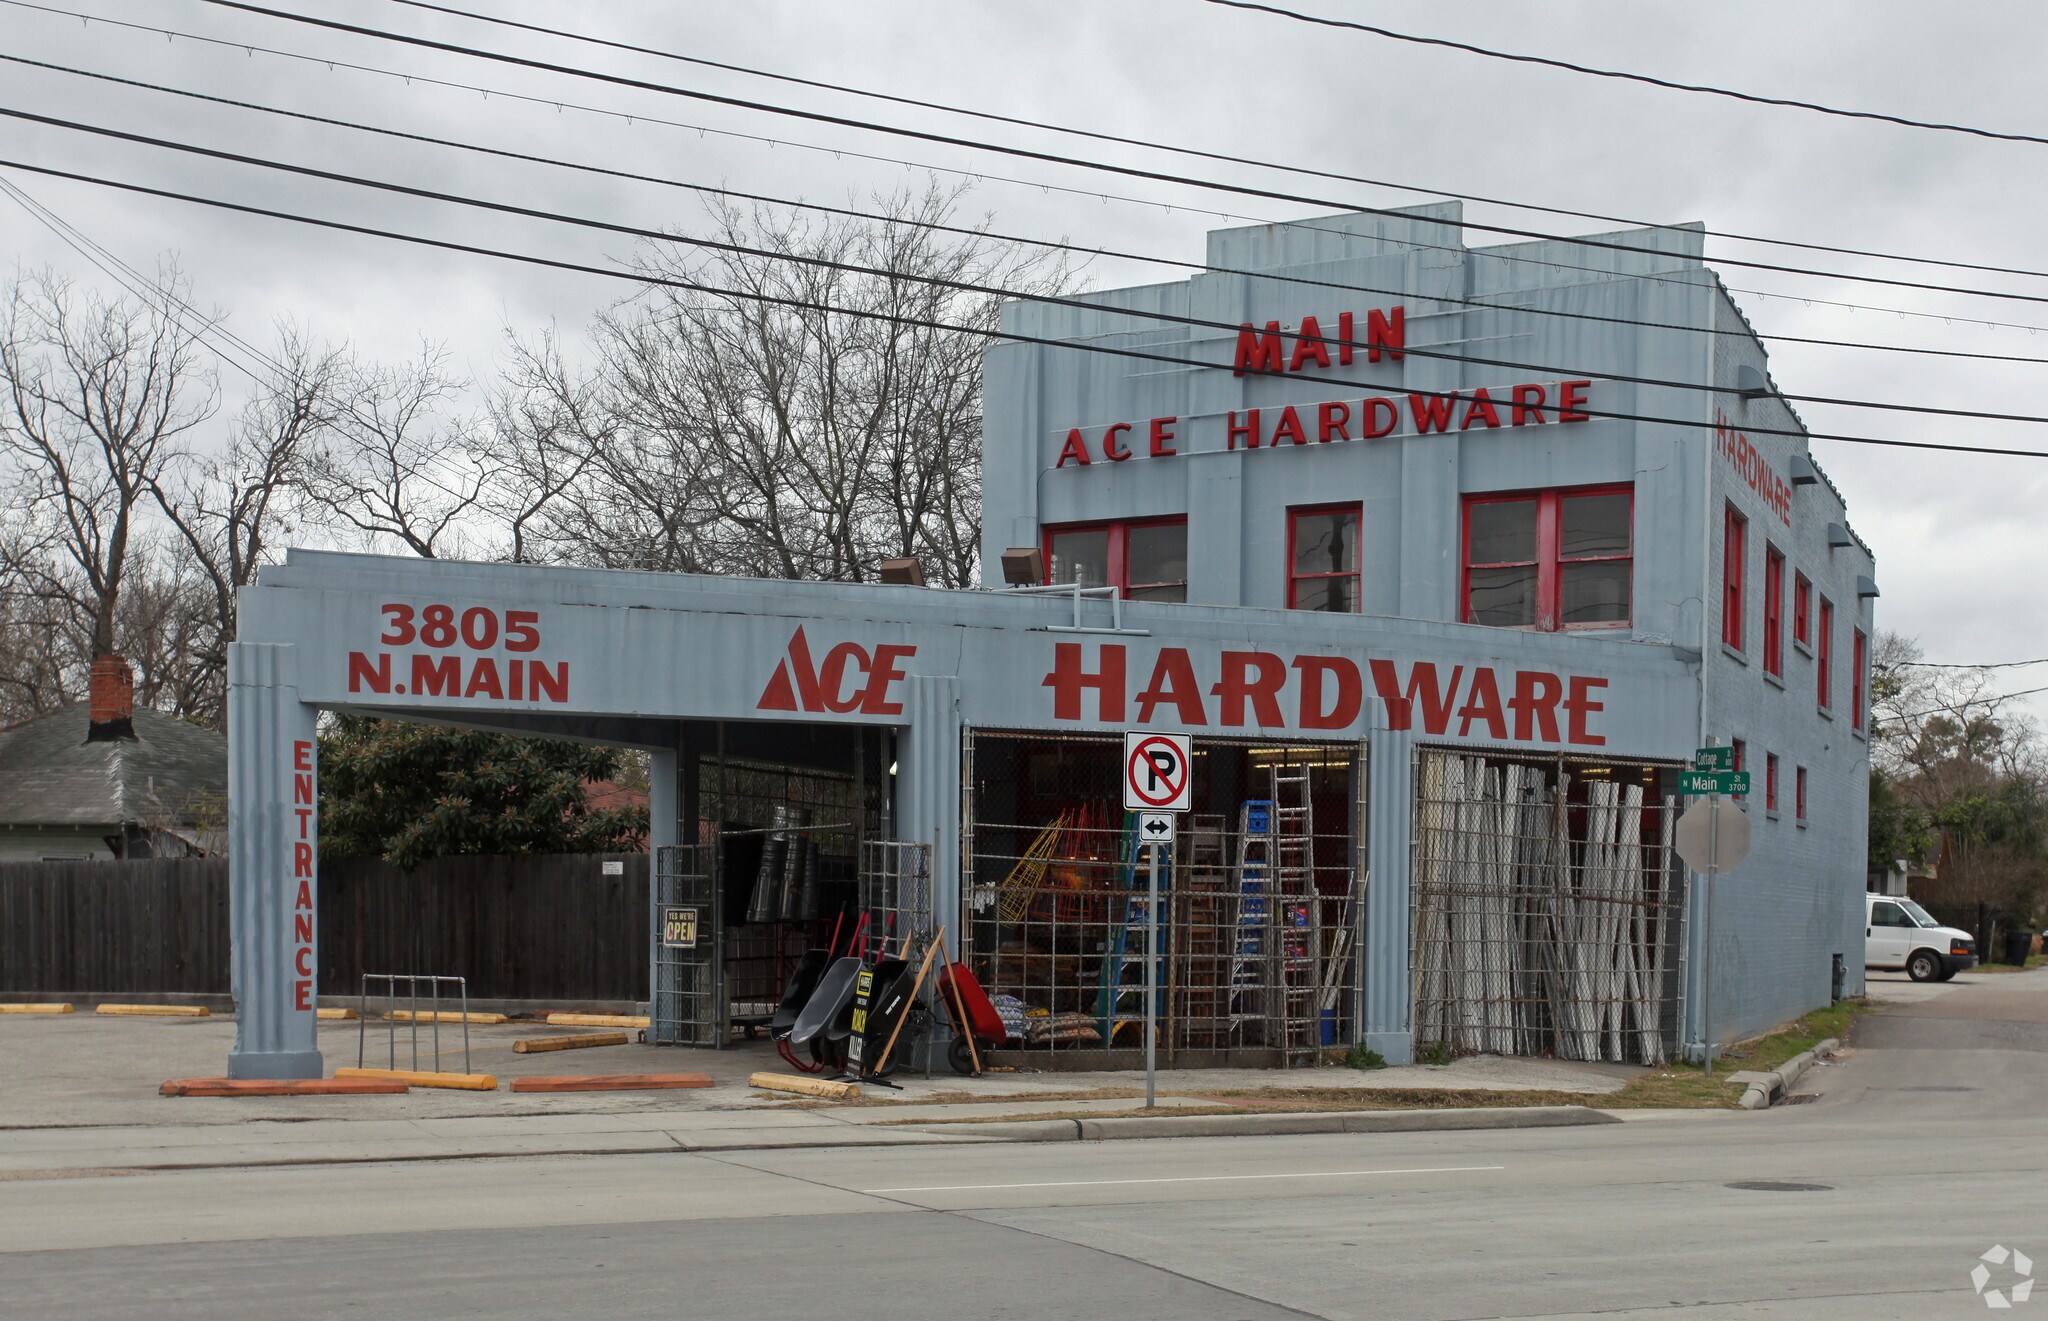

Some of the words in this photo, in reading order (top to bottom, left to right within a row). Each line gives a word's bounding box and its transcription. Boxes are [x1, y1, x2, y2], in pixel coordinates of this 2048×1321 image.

[1233, 306, 1405, 377] MAIN
[1056, 416, 1177, 468] ACE
[1227, 380, 1592, 451] HARDWARE
[1717, 407, 1792, 528] HARDWARE
[382, 603, 540, 652] 3805
[348, 652, 570, 703] N.MAIN
[759, 623, 917, 716] ACE
[1041, 642, 1608, 747] HARDWARE
[1148, 750, 1176, 792] P
[1692, 777, 1717, 790] Main
[1697, 752, 1717, 769] Cottage
[1729, 783, 1746, 791] 3700
[294, 741, 312, 1011] ENTRANCE
[666, 921, 695, 941] OPEN
[668, 912, 679, 920] YES
